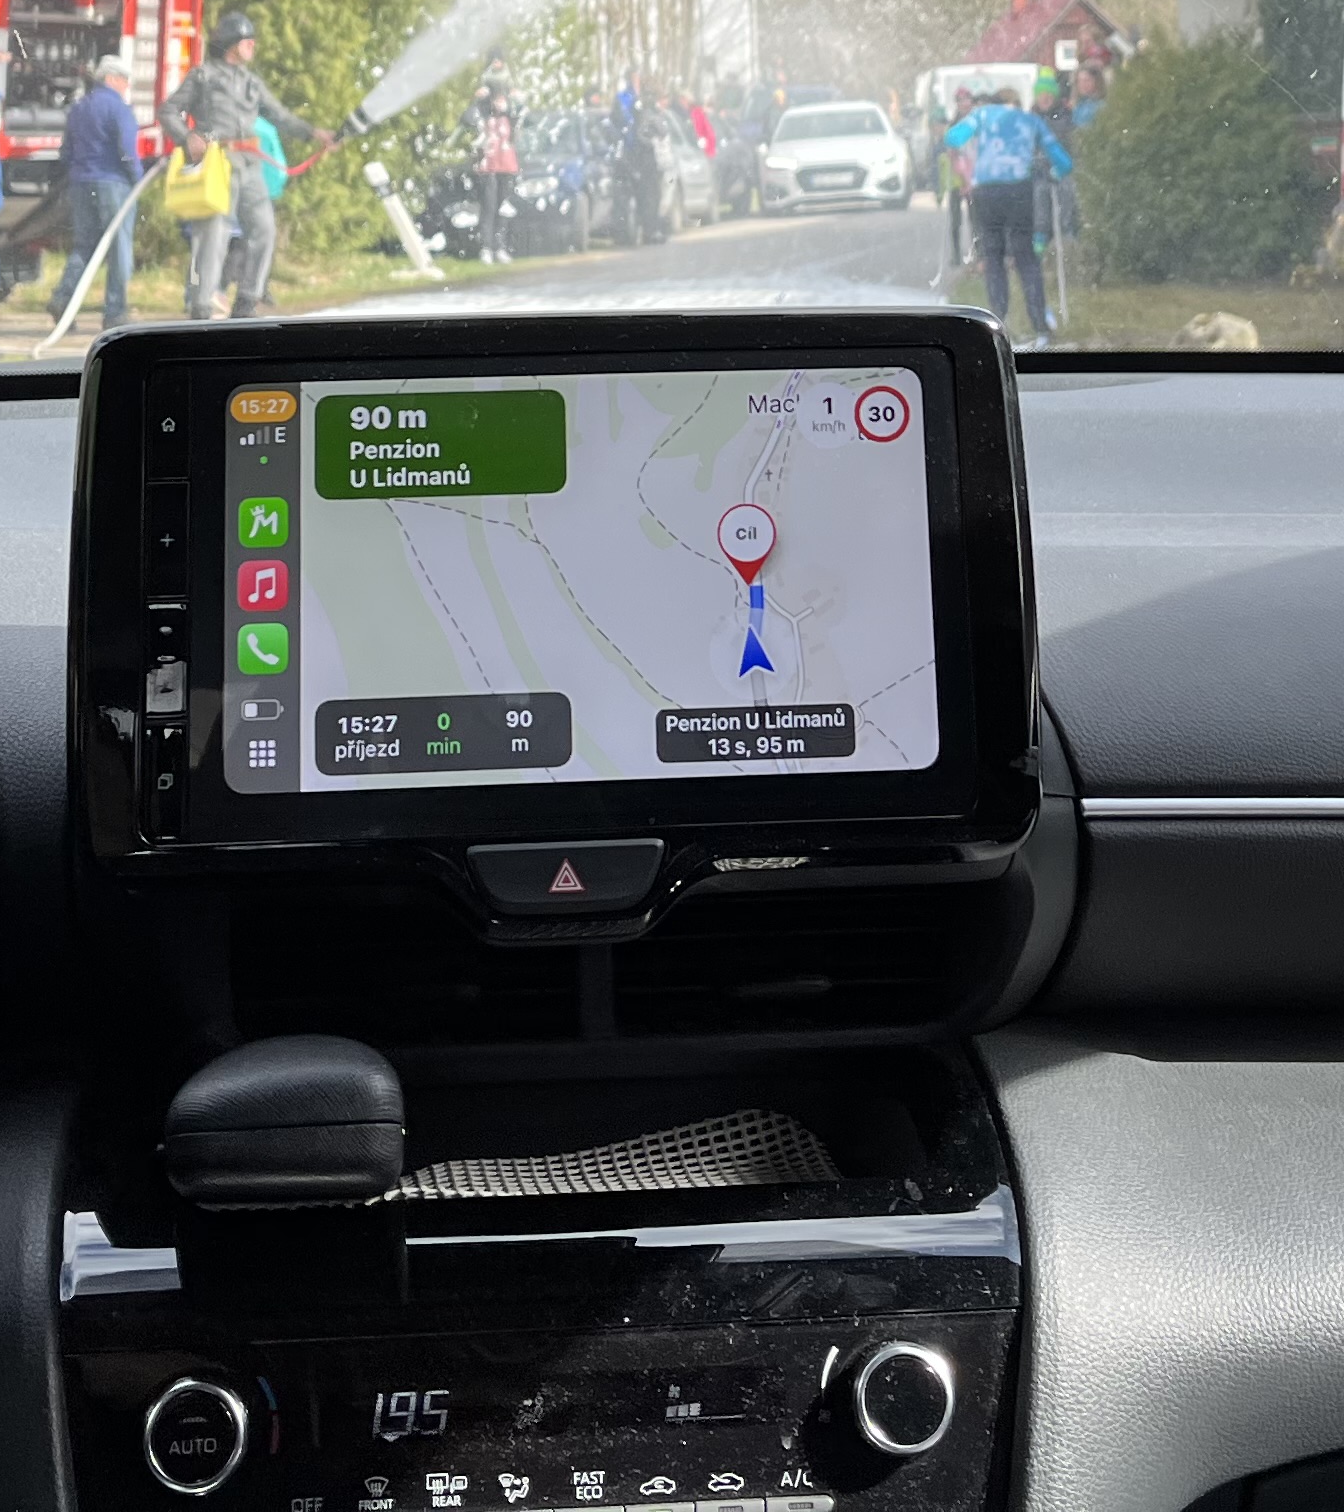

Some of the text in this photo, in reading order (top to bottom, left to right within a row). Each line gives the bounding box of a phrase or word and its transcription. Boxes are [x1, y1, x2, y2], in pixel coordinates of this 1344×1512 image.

[238, 398, 289, 415] 15:27
[748, 394, 800, 415] Mac
[822, 397, 832, 415] 1
[350, 405, 427, 430] 90 m
[868, 406, 895, 422] 30
[274, 426, 287, 444] E
[812, 420, 846, 434] km/h
[349, 439, 441, 460] Penzion
[349, 463, 471, 488] U Lidmanů
[337, 715, 398, 734] 15:27
[437, 712, 451, 731] 0
[505, 710, 533, 728] 90
[665, 707, 846, 732] Penzion U Lidmanů
[334, 739, 400, 762] příjezd
[426, 737, 462, 756] min
[511, 737, 530, 753] m
[708, 737, 805, 758] 13 s, 95 m
[169, 1437, 218, 1456] AUTO
[573, 1471, 606, 1486] FAST
[432, 1495, 462, 1508] REAR
[575, 1486, 604, 1500] ECO
[292, 1497, 324, 1512] OFF
[359, 1498, 395, 1512] FRONT
